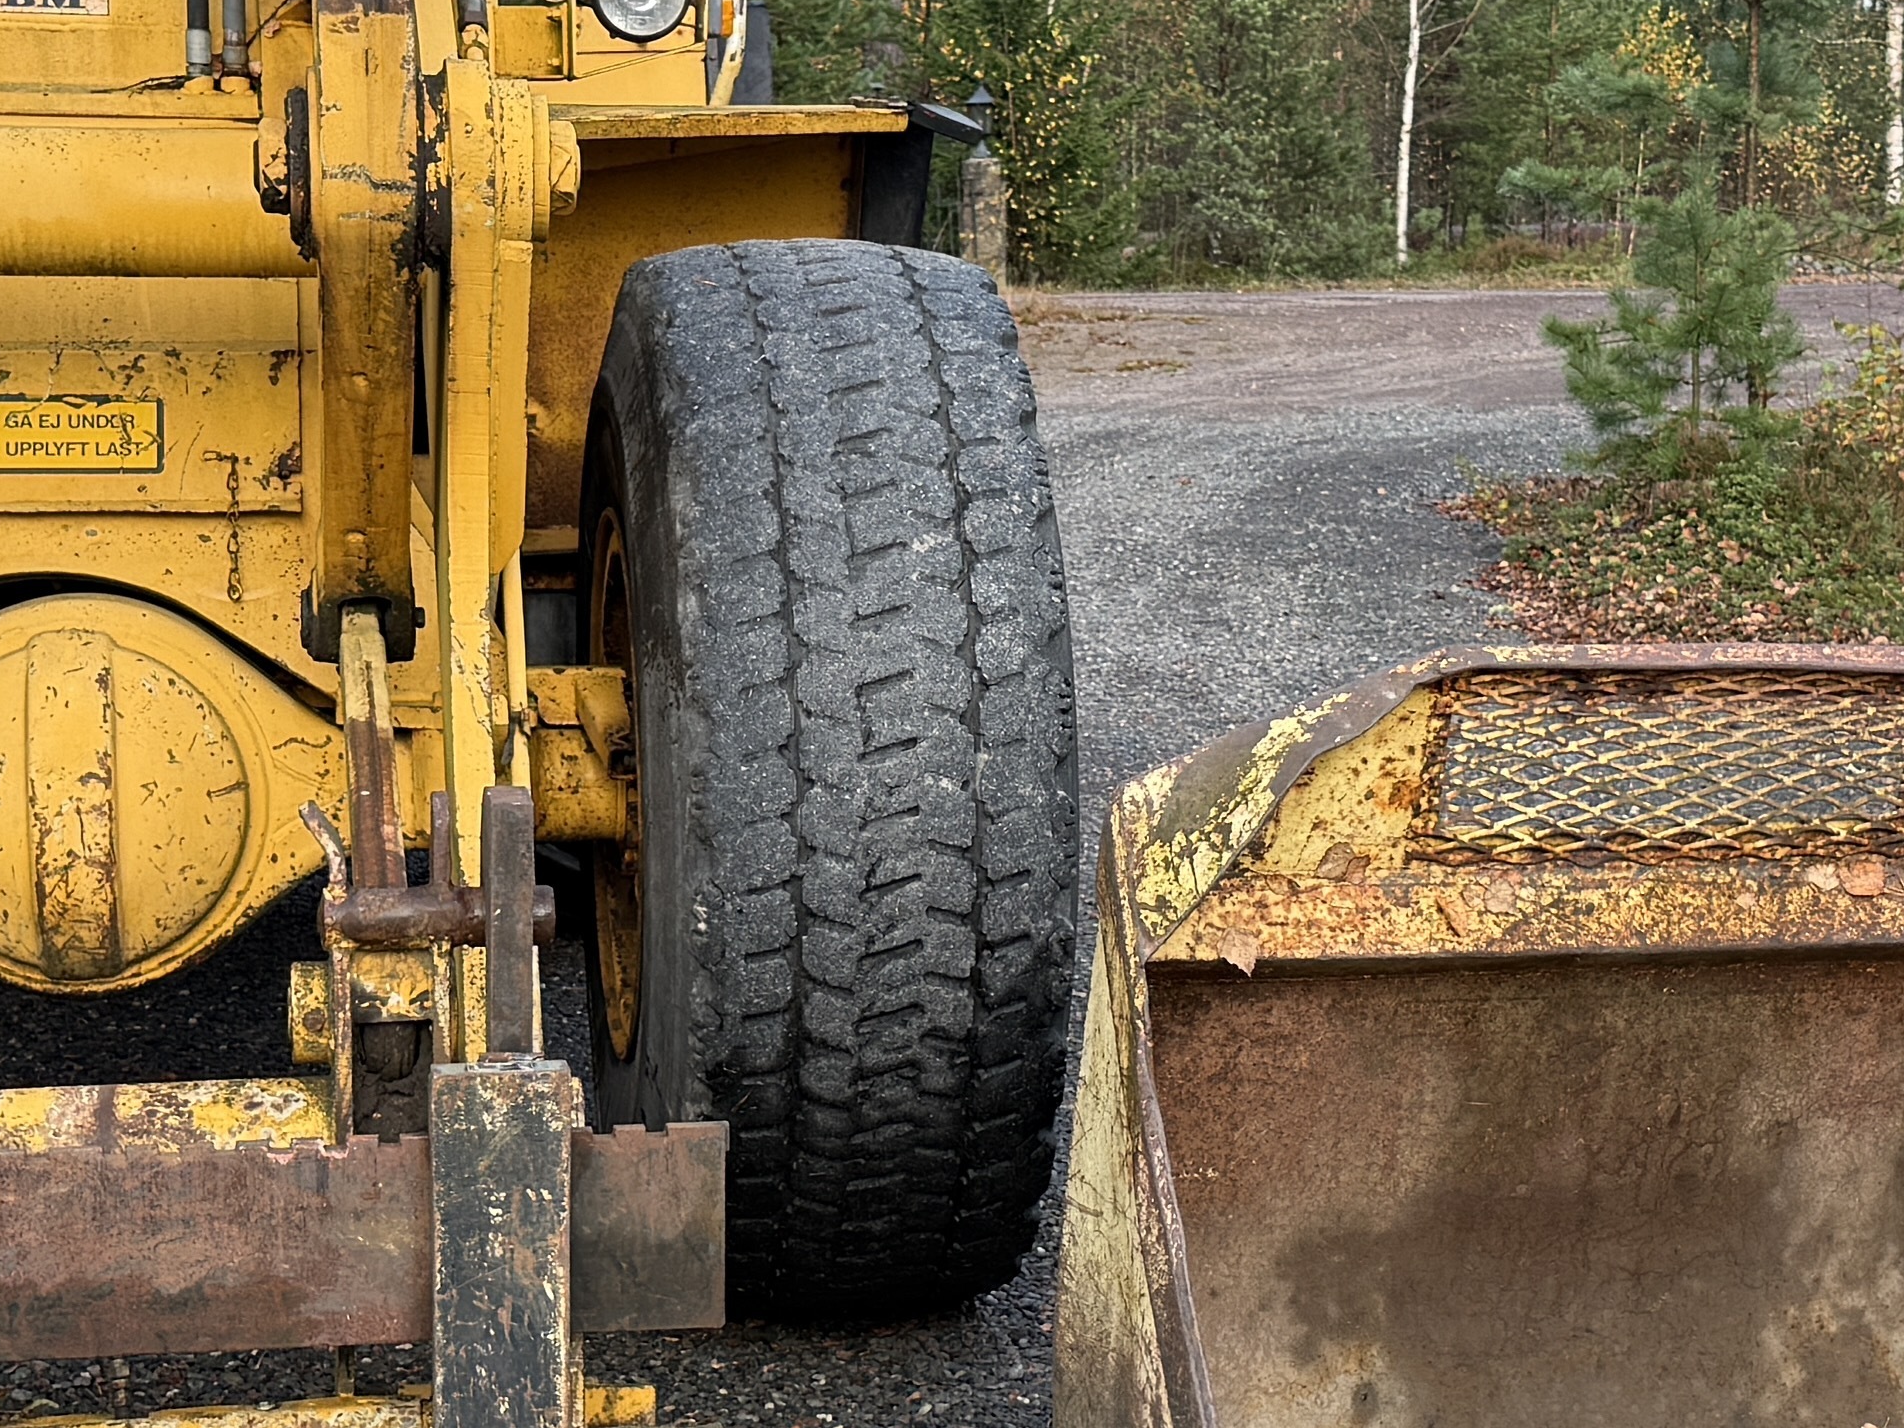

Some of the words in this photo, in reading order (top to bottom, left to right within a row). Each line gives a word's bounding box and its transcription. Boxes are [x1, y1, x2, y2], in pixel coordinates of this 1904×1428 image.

[39, 414, 61, 429] EJ
[68, 413, 135, 429] UNDER
[5, 441, 90, 457] UPPLYFT
[95, 441, 143, 457] LAST
